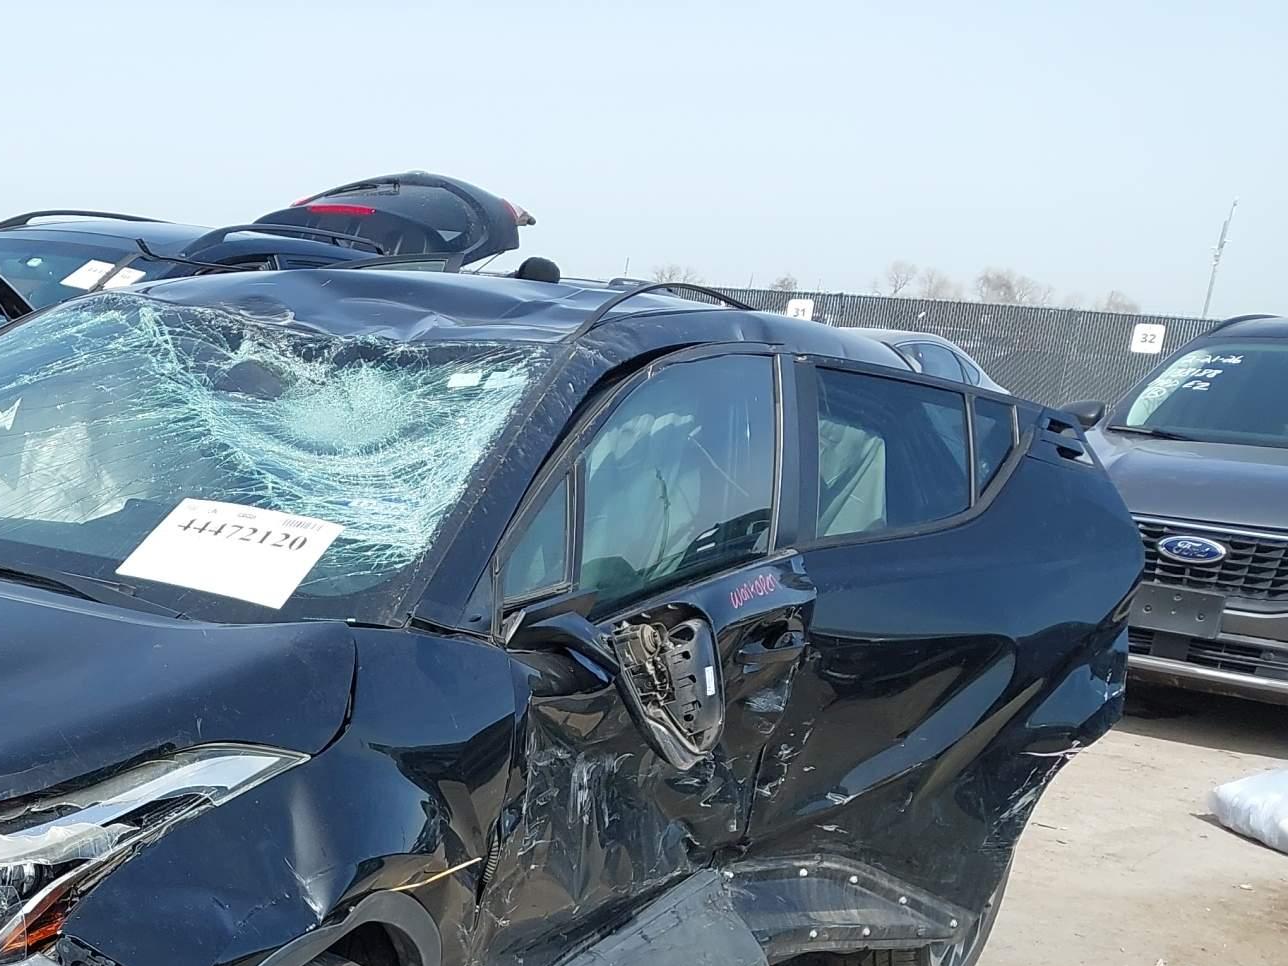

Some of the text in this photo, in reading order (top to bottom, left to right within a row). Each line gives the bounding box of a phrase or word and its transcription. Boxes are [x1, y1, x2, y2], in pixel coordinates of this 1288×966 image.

[793, 308, 806, 317] 31
[1140, 333, 1157, 344] 32
[177, 518, 308, 551] 44472120
[1172, 540, 1210, 558] Ford
